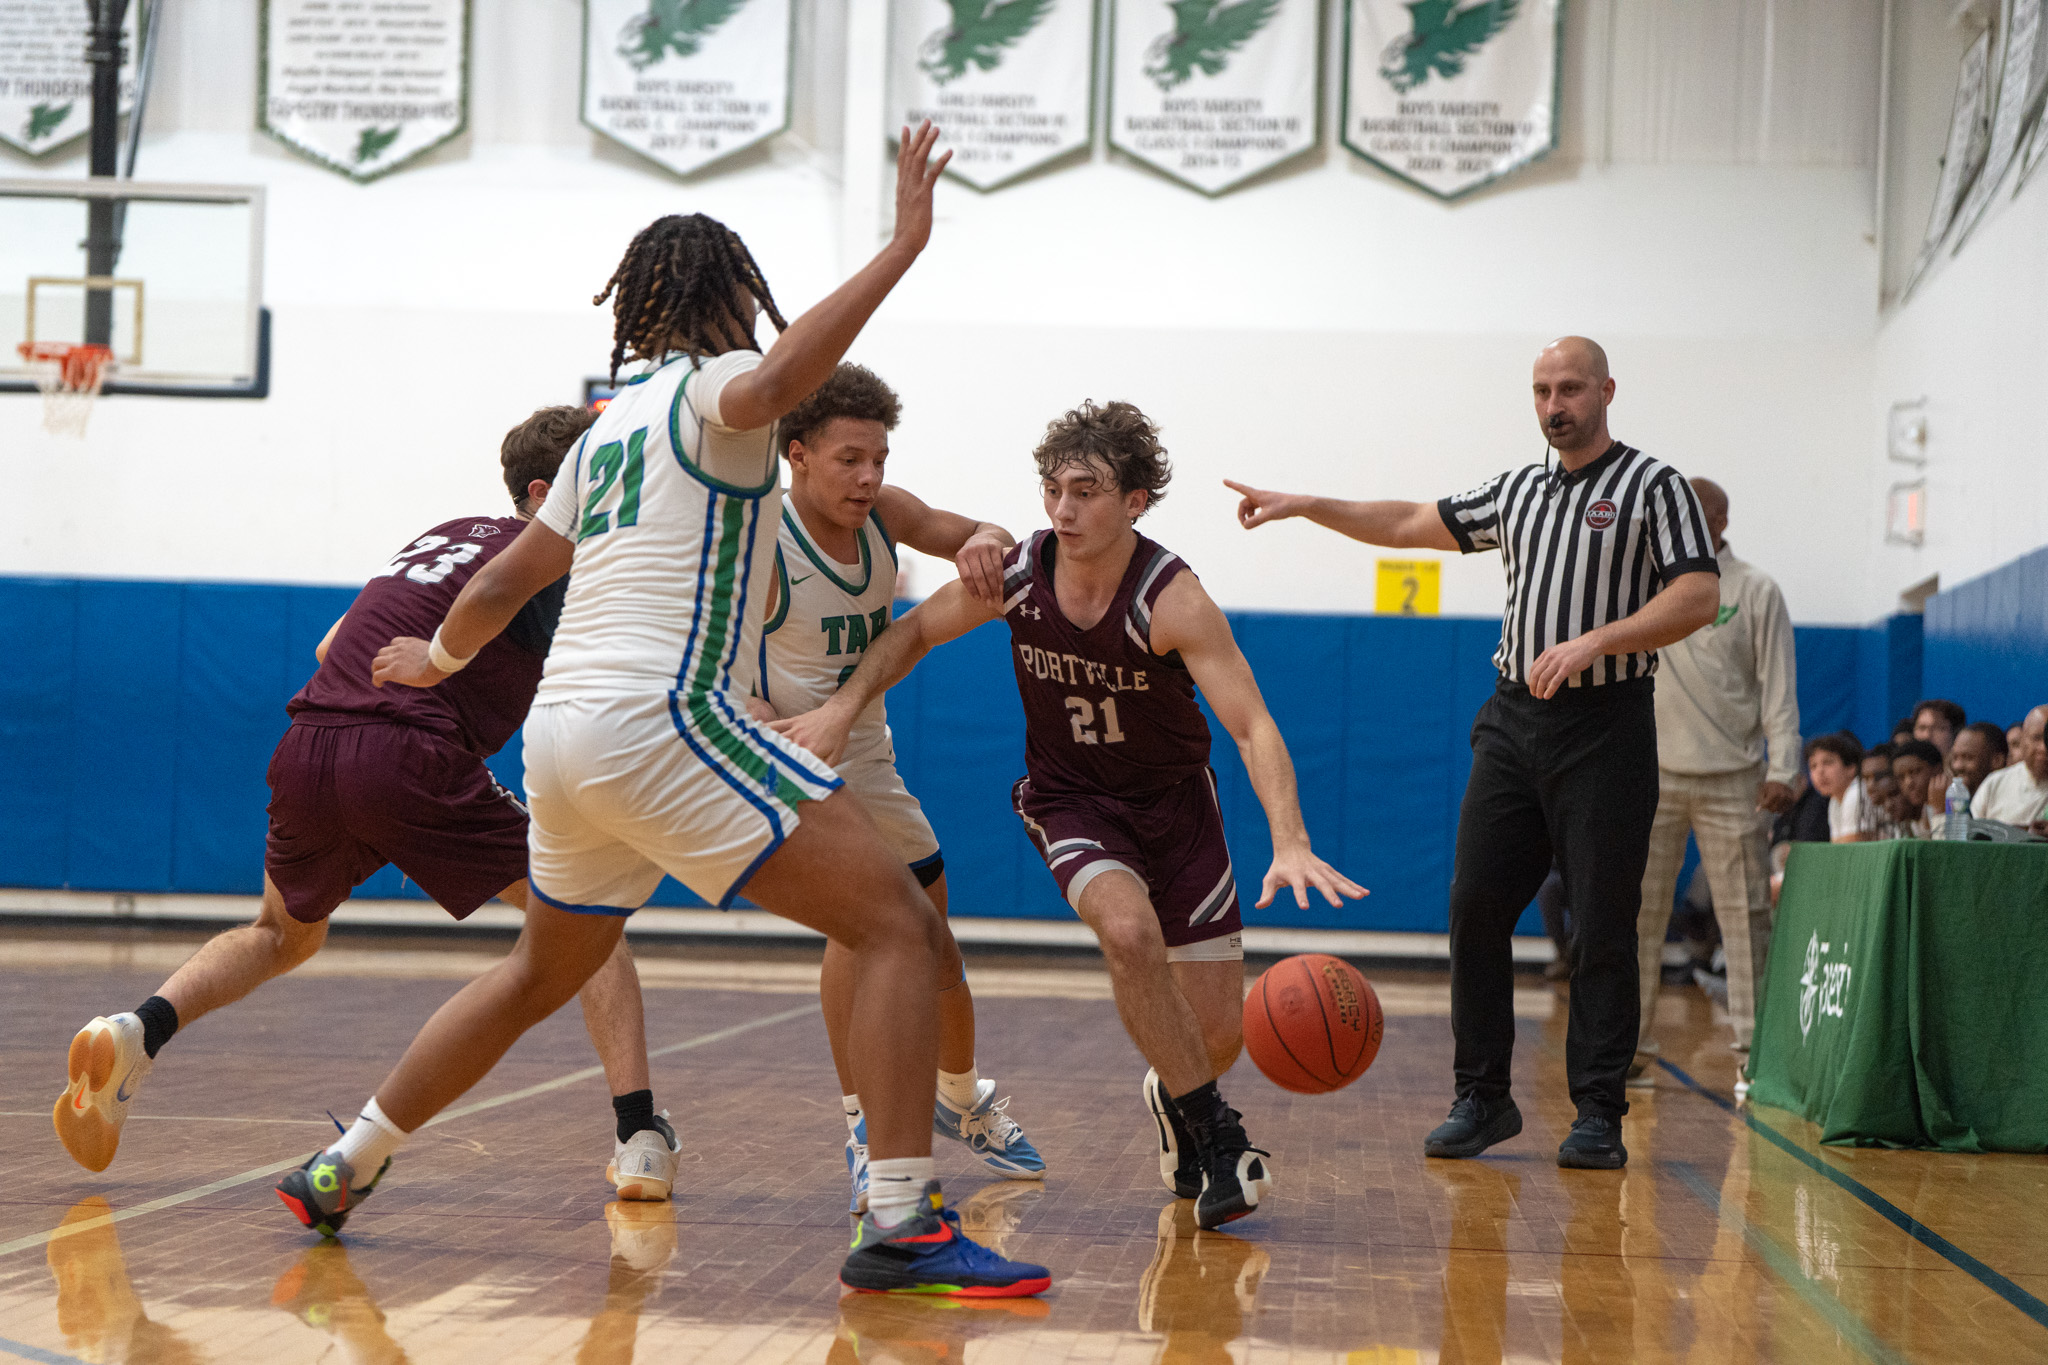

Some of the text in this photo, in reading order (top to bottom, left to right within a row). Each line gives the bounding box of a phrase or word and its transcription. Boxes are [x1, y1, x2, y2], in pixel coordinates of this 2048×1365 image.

[577, 425, 649, 545] 21
[371, 535, 485, 585] 23
[1064, 696, 1125, 744] 21
